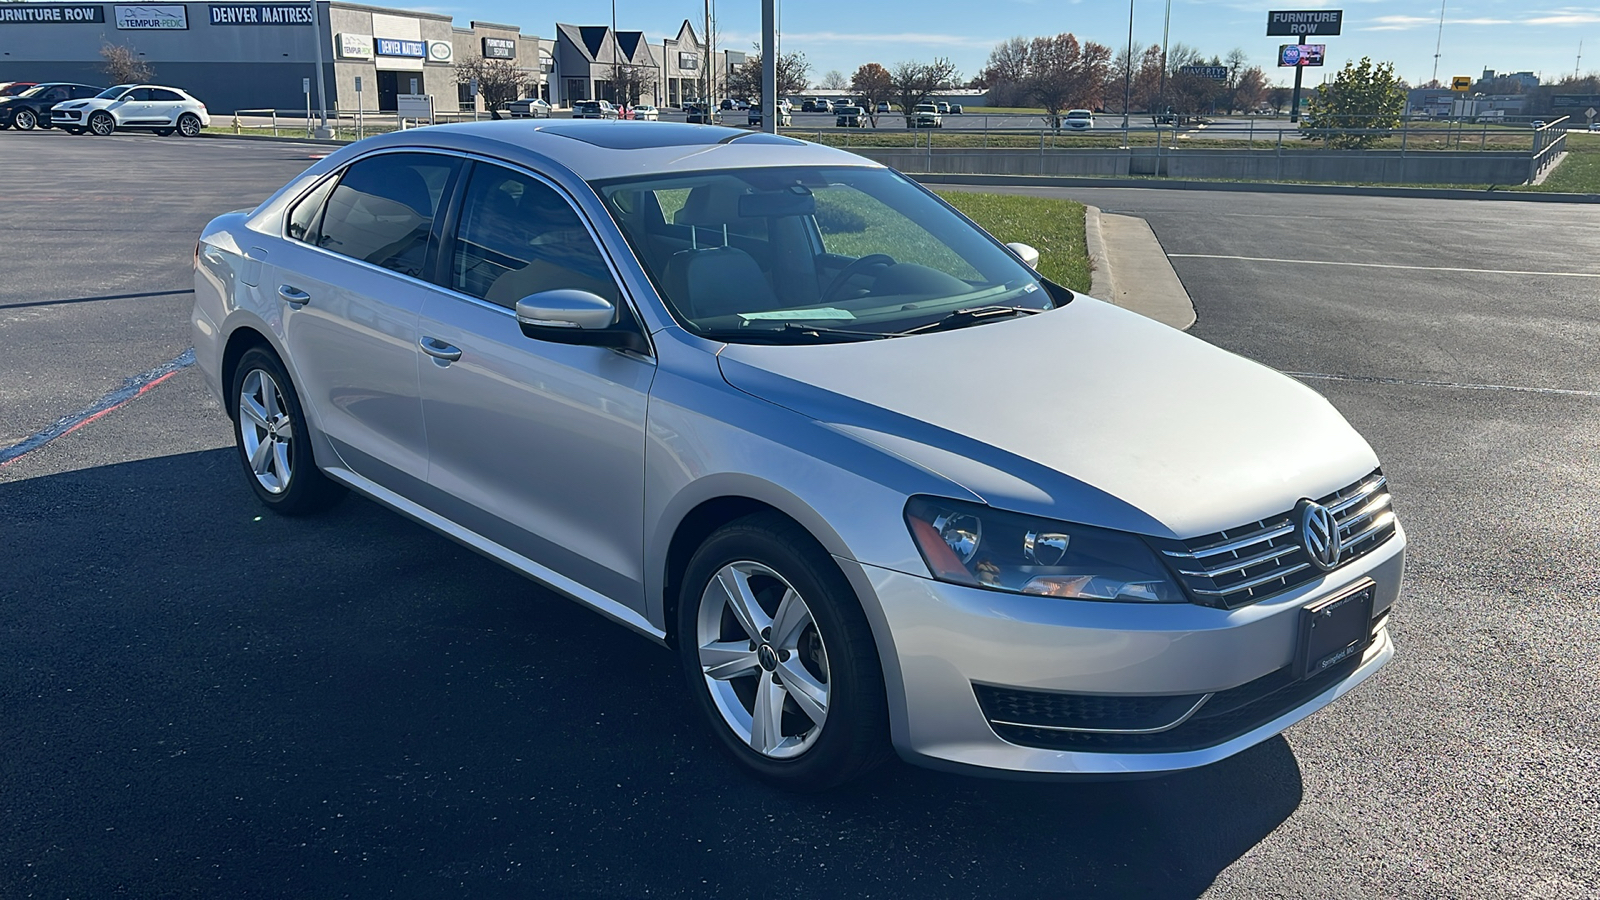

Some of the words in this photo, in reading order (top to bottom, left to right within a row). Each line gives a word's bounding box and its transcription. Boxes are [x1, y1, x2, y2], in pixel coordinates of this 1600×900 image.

[65, 8, 94, 21] ROW
[213, 7, 258, 23] DENVER
[262, 7, 313, 23] MATTRESS
[1273, 12, 1338, 23] FURNITURE
[125, 19, 183, 28] TEMPUR-PEDIC
[1290, 23, 1318, 34] ROW
[381, 40, 401, 54] DENVER
[401, 41, 423, 56] MATTRESS
